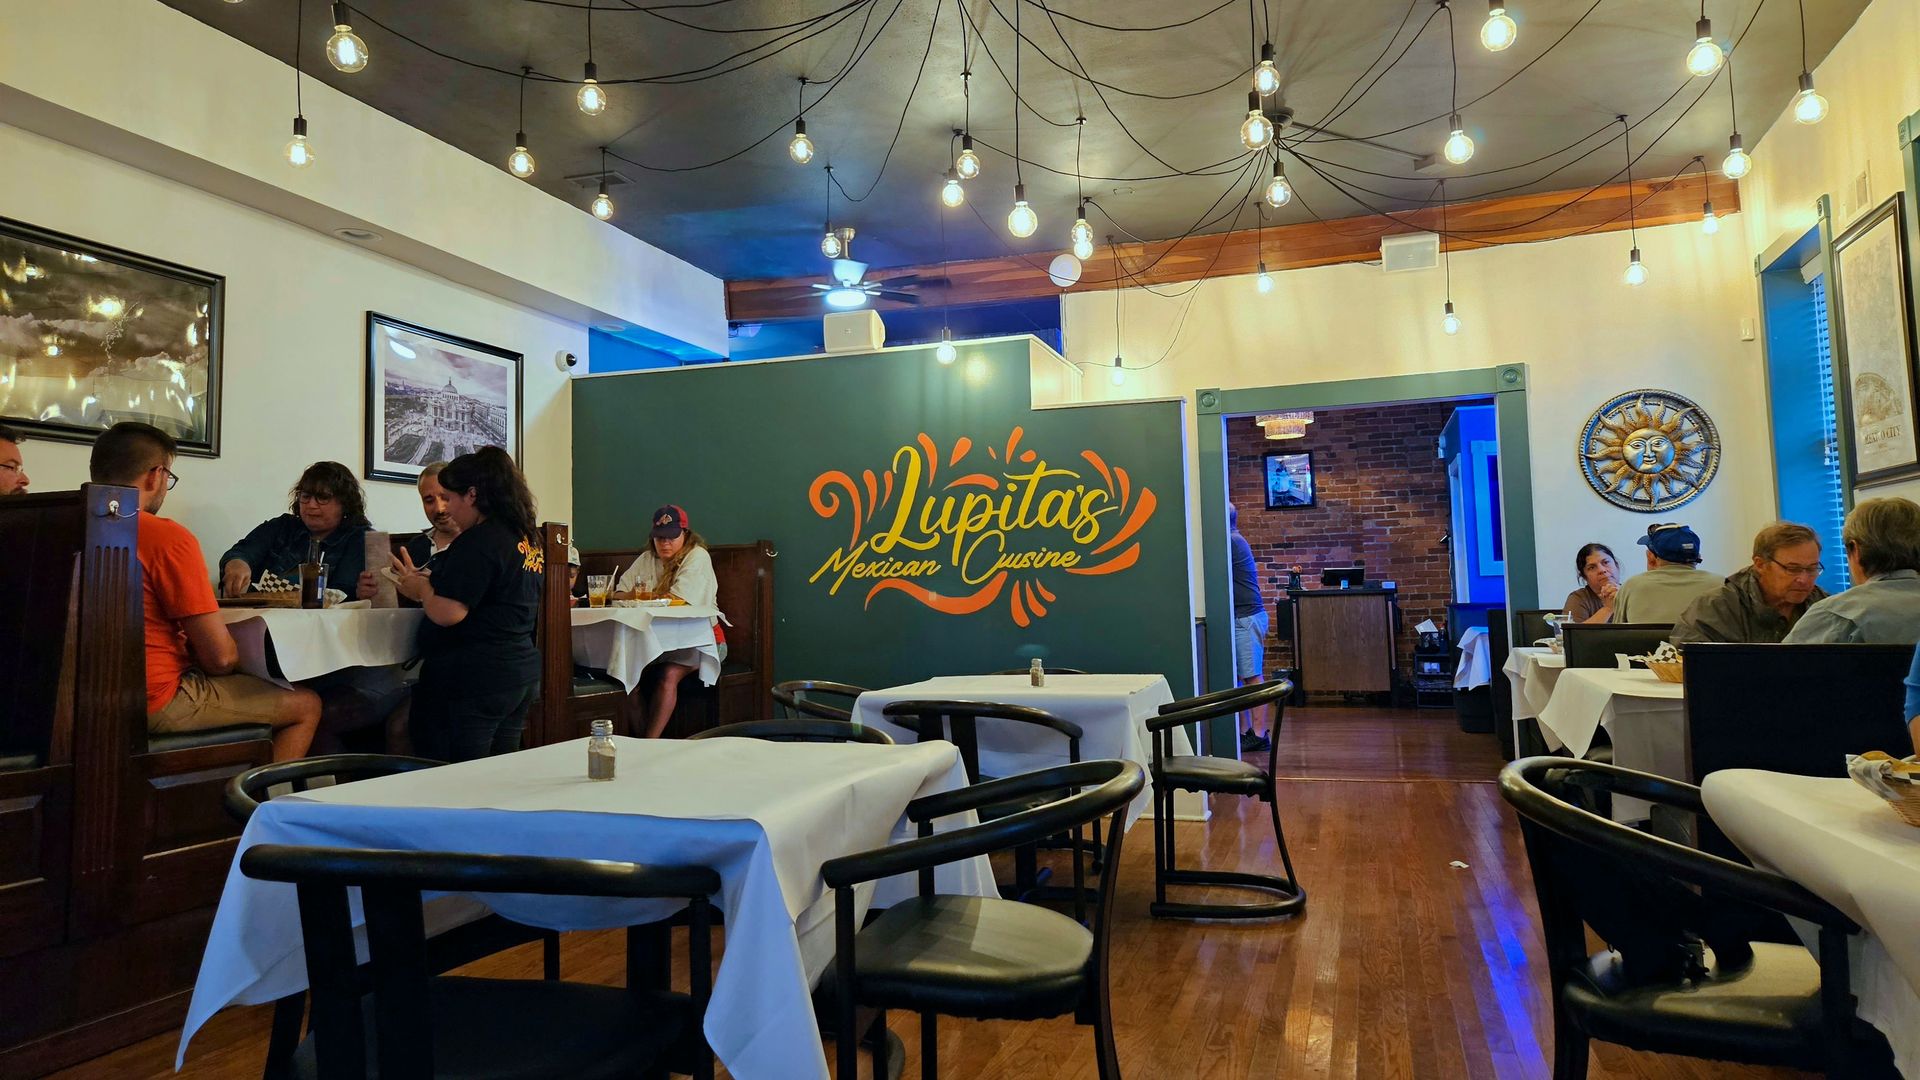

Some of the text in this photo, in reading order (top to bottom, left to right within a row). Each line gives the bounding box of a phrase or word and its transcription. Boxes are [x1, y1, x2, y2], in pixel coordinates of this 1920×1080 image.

[870, 446, 1119, 567] Lupita's
[809, 529, 1082, 595] Mexican Cuisine
